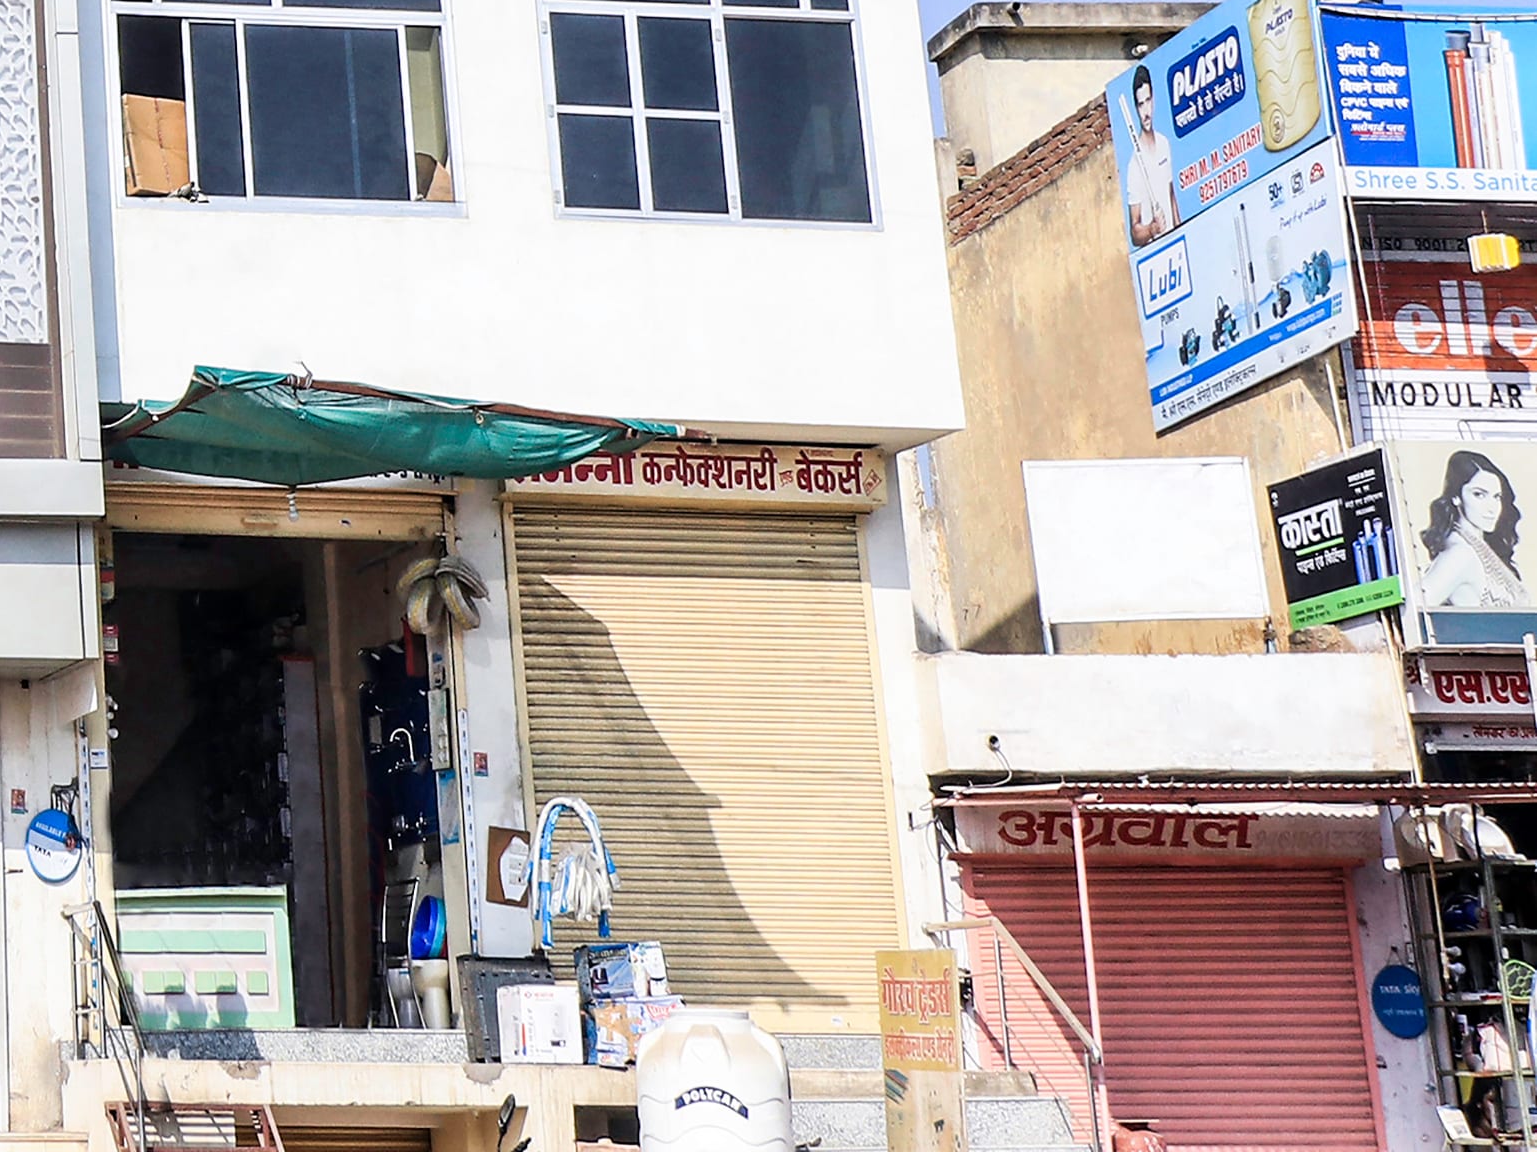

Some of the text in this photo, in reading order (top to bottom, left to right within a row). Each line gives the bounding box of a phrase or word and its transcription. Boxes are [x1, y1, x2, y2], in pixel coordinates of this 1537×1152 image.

[1173, 35, 1239, 106] PLASTO
[1337, 60, 1407, 77] सबसे अधिक
[1178, 124, 1262, 190] SHRI M. M. SANITARY
[1355, 170, 1417, 189] Shree
[1426, 171, 1465, 190] S.S.
[1149, 252, 1182, 302] Lubi
[1371, 381, 1523, 409] MODULAR
[641, 446, 778, 491] कन्फेक्शनरी
[795, 449, 863, 494] बेकर्स
[1278, 498, 1344, 550] कास्ता
[34, 845, 51, 857] TATA
[1379, 985, 1401, 994] TATA
[682, 1087, 742, 1113] POLYCAN
